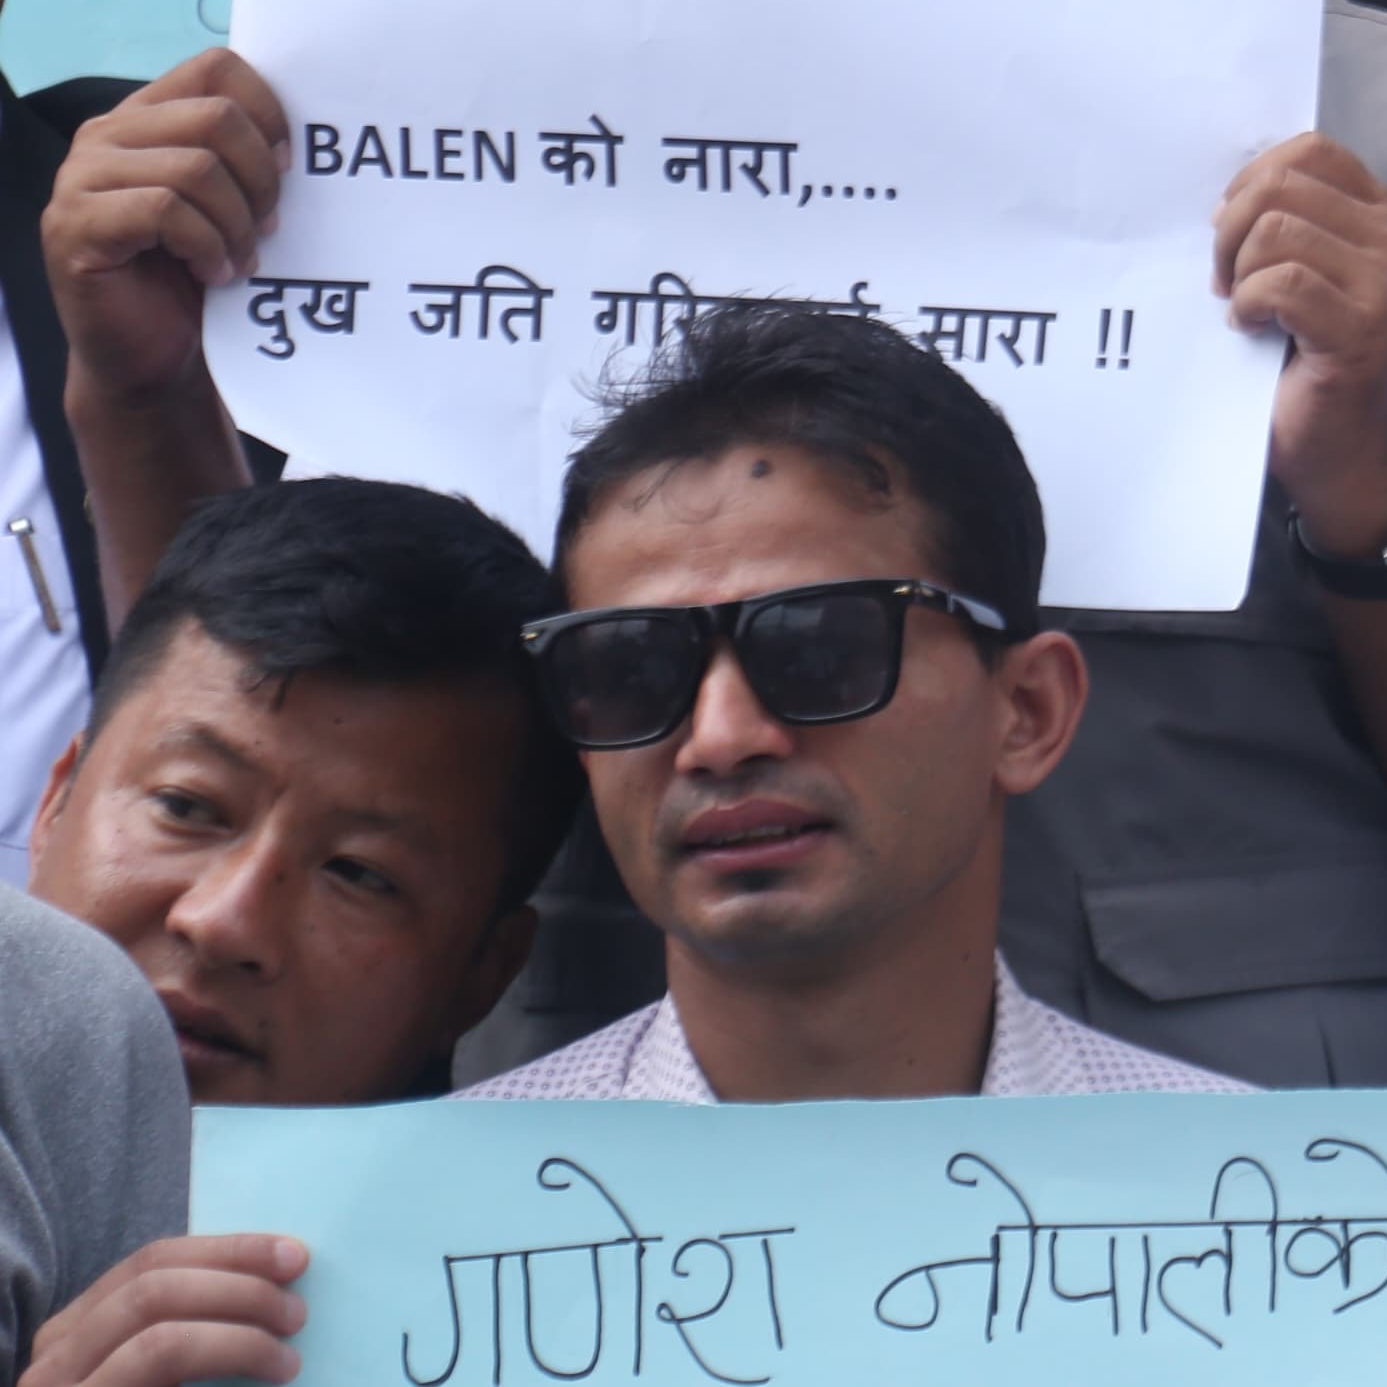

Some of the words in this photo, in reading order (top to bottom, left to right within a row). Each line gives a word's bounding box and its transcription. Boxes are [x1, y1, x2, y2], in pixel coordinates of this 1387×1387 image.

[305, 122, 516, 184] BALEN
[538, 113, 624, 188] को
[246, 276, 371, 361] दुख
[407, 264, 555, 344] जति
